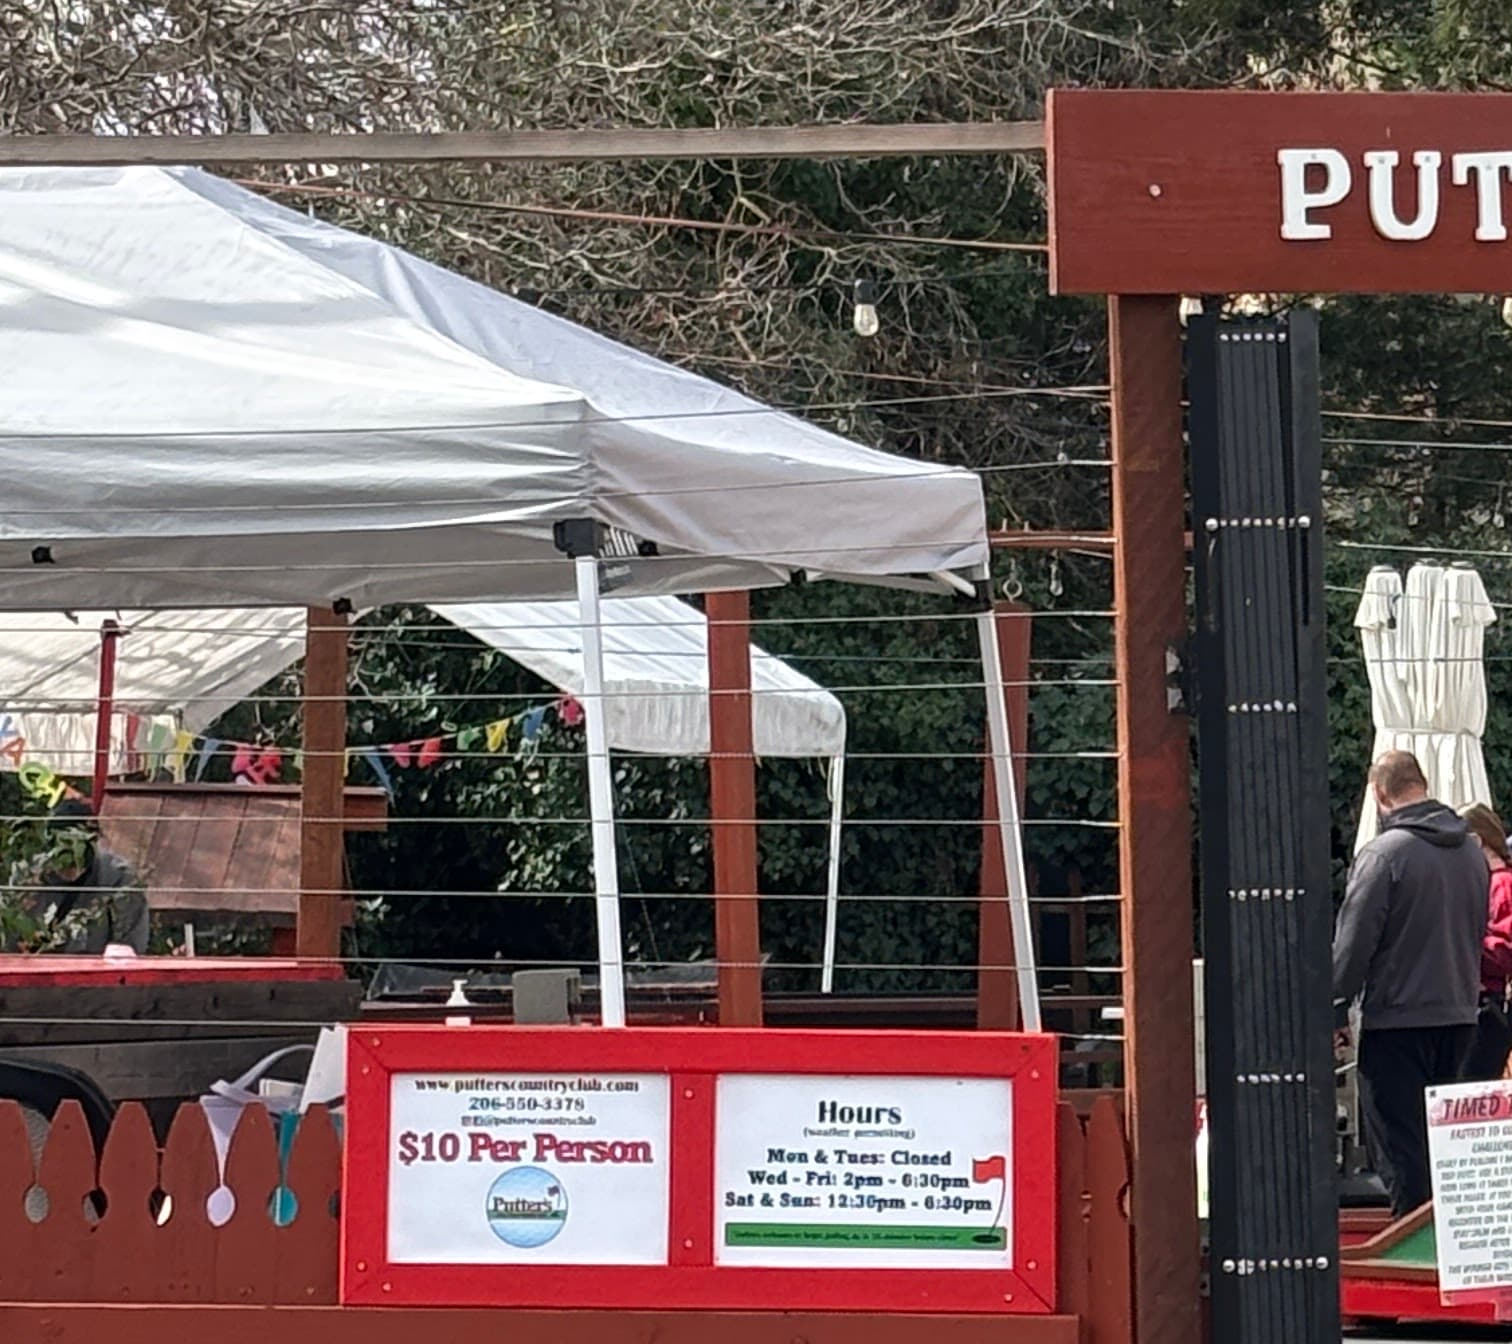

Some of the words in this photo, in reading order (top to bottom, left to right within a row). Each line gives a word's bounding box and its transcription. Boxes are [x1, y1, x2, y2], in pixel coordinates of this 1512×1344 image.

[818, 1100, 903, 1124] Hours
[1442, 1093, 1501, 1121] TIMED
[399, 1130, 461, 1166] $10
[468, 1132, 528, 1163] Per
[533, 1132, 654, 1164] Person
[767, 1148, 809, 1164] Mon
[814, 1149, 828, 1164] &
[891, 1150, 953, 1166] Closed
[748, 1170, 788, 1186] Wed
[805, 1171, 837, 1186] Fri:
[843, 1172, 883, 1190] 2pm
[902, 1173, 969, 1192] 6:30pm
[725, 1192, 755, 1208] Sat
[760, 1193, 774, 1207] &
